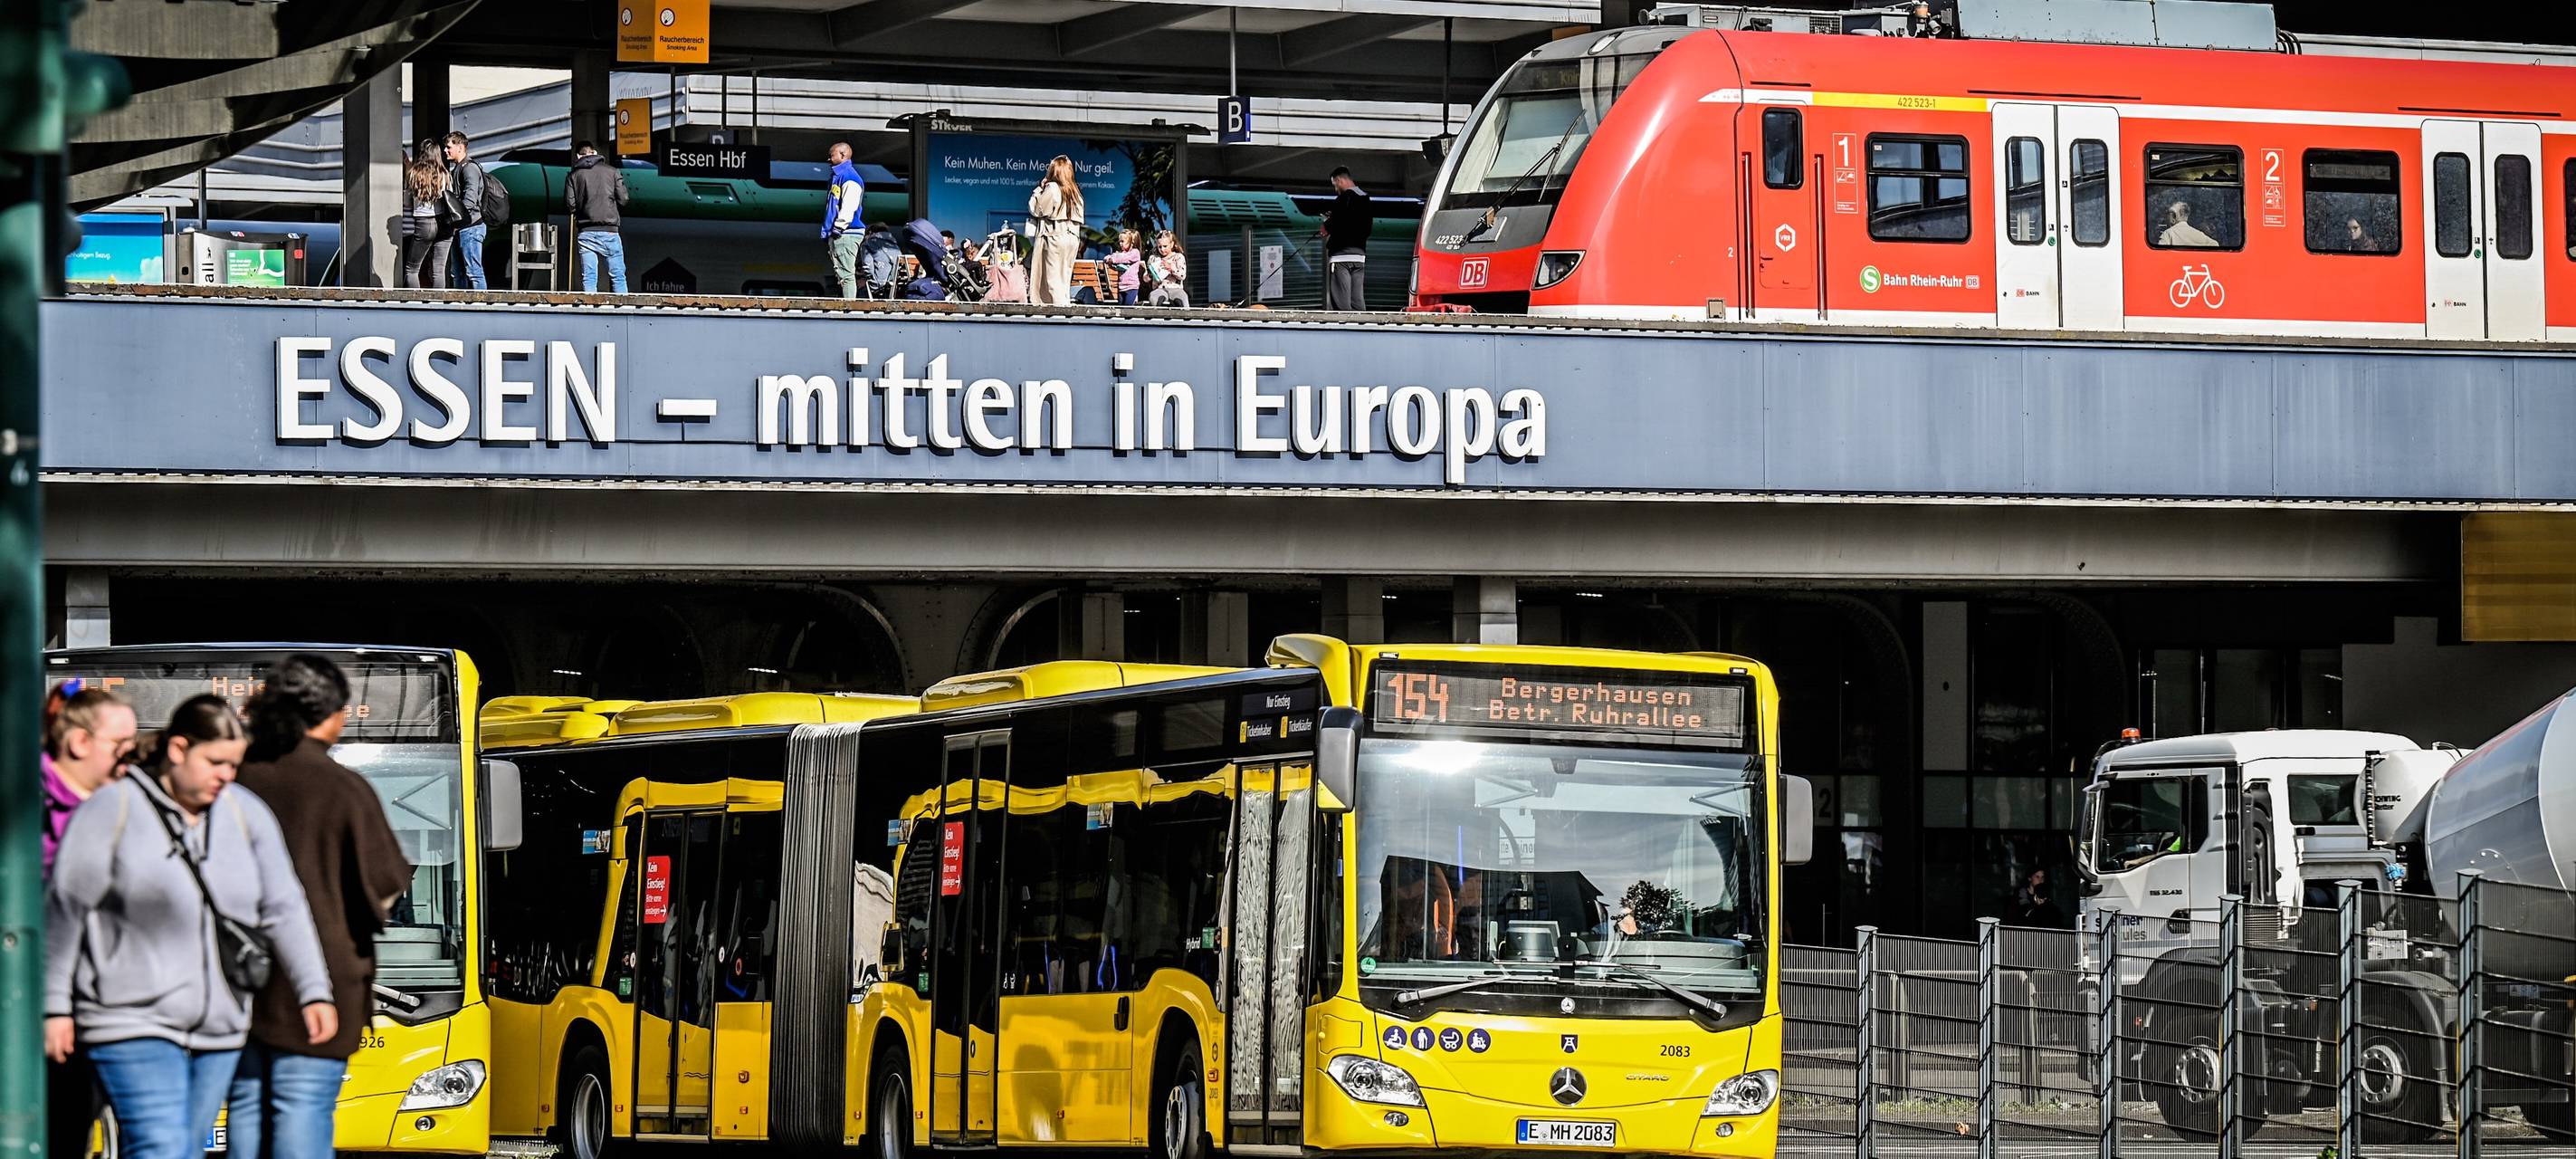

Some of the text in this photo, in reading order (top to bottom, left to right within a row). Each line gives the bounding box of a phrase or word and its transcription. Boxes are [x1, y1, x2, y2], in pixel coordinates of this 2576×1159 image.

[659, 35, 704, 43] Raucherbereich
[1897, 98, 1936, 109] 422 523-1
[1227, 101, 1243, 133] B
[670, 148, 747, 169] Essen Hbf
[1837, 136, 1849, 168] 1
[944, 156, 966, 168] Kein
[968, 156, 1003, 170] Muhen.
[1006, 158, 1026, 170] Kein
[1074, 160, 1092, 173] Nur
[1094, 161, 1114, 177] geil.
[2265, 151, 2280, 181] 2
[944, 177, 962, 185] Lecker,
[962, 178, 978, 187] vegan
[978, 177, 990, 185] und
[1098, 181, 1115, 189] Kakao.
[1435, 235, 1449, 244] 422
[1779, 234, 1791, 242] VRR
[1727, 247, 1734, 258] 2
[201, 263, 215, 283] all
[1461, 261, 1487, 284] DB
[1863, 267, 1979, 292] S Bahn Rhein-Ruhr DB
[646, 281, 685, 292] Ich fahre
[275, 336, 615, 445] ESSEN
[757, 347, 1073, 453] mitten
[1113, 352, 1195, 454] in
[1234, 354, 1546, 484] Europa
[1266, 694, 1291, 710] Nur Einstieg
[1388, 673, 1692, 723] 154 Bergerhausen
[1489, 699, 1703, 728] Betr. Ruhrallee
[1247, 723, 1273, 737] Ticketinhaber
[945, 828, 954, 840] Kein
[944, 845, 960, 861] Einstieg!
[647, 861, 658, 873] Kein
[646, 877, 666, 892] Einstieg!
[1186, 936, 1201, 953] Hybrid
[359, 1036, 385, 1049] 926
[1660, 1044, 1691, 1058] 2083
[1529, 1123, 1539, 1139] E
[1550, 1124, 1571, 1140] MH
[1574, 1125, 1613, 1141] 2083
